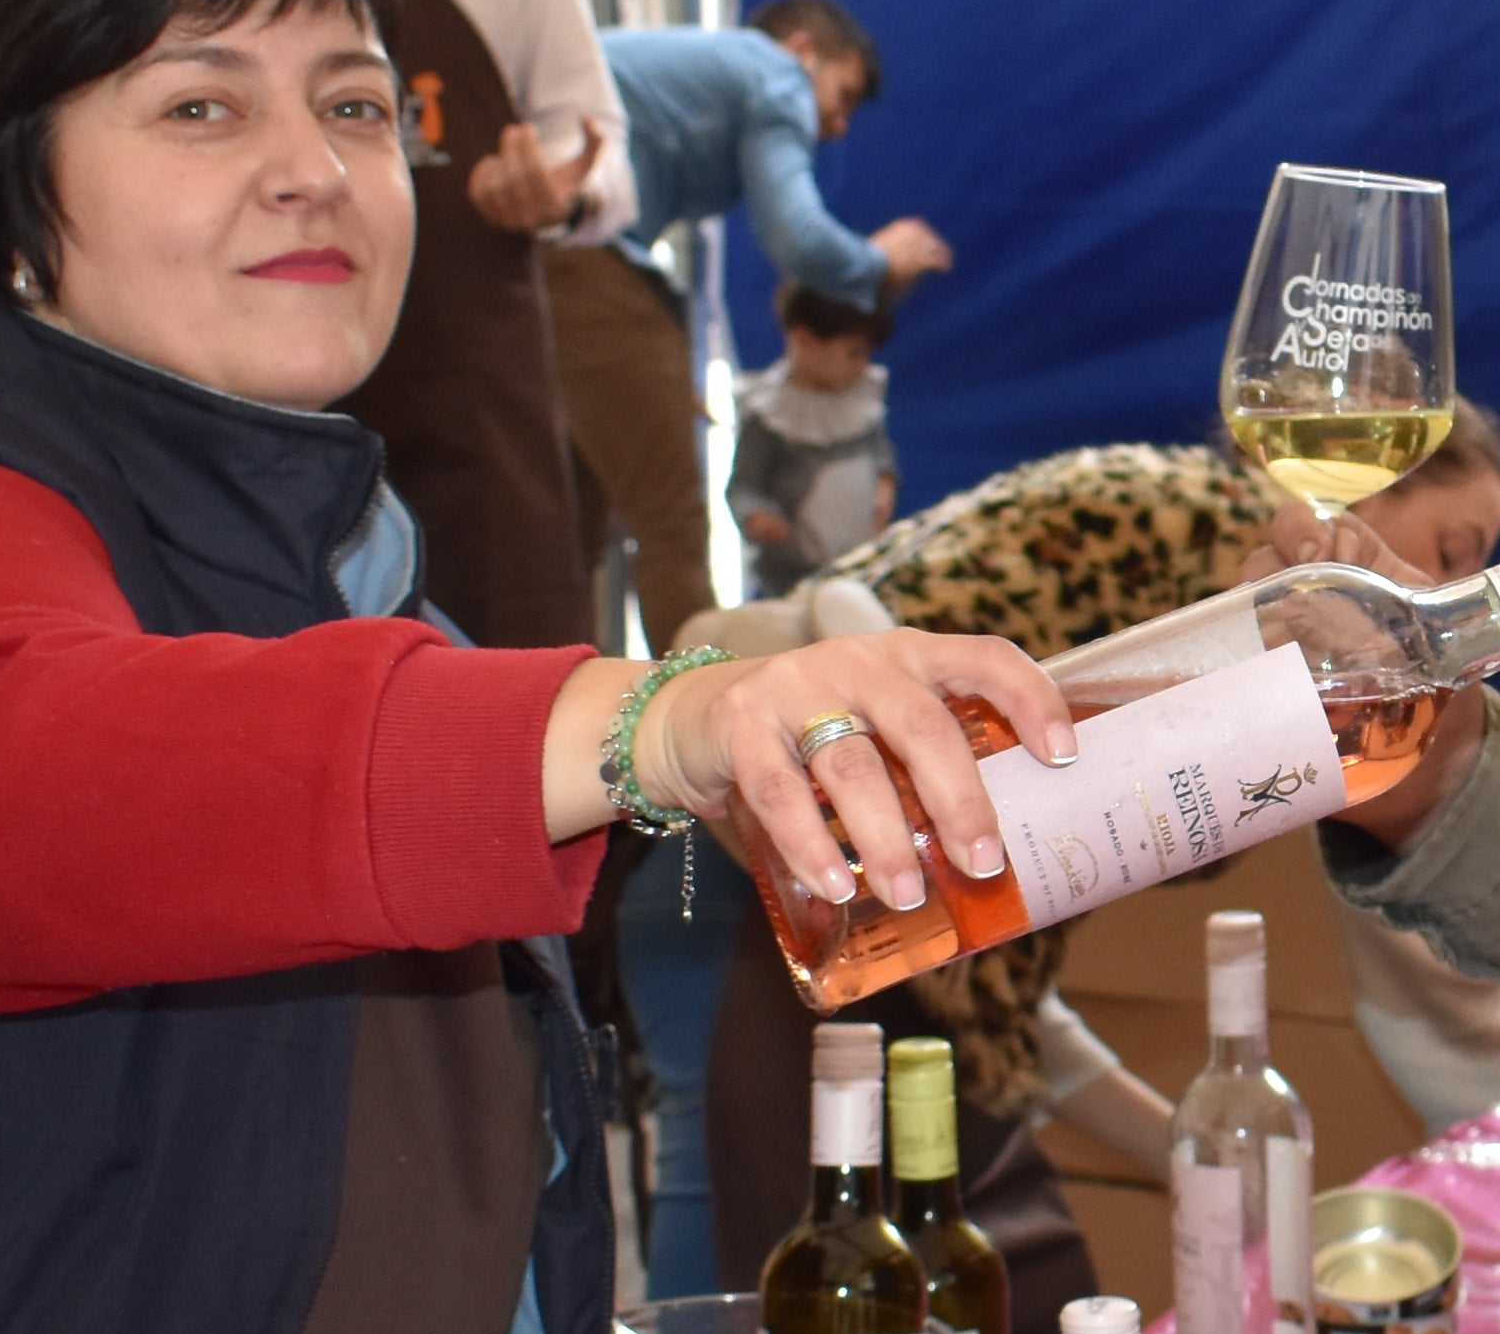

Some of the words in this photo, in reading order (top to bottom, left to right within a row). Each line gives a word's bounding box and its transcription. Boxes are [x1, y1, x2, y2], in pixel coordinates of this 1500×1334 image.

[1283, 275, 1433, 331] Champiñón
[1304, 252, 1405, 304] Jornadas
[1270, 322, 1350, 372] Autol
[1303, 316, 1370, 352] Seta
[1168, 769, 1211, 864] REINOSA
[1190, 763, 1223, 841] MARQUÉS
[1103, 811, 1125, 857] ROSADO
[1157, 812, 1177, 856] RIOJA
